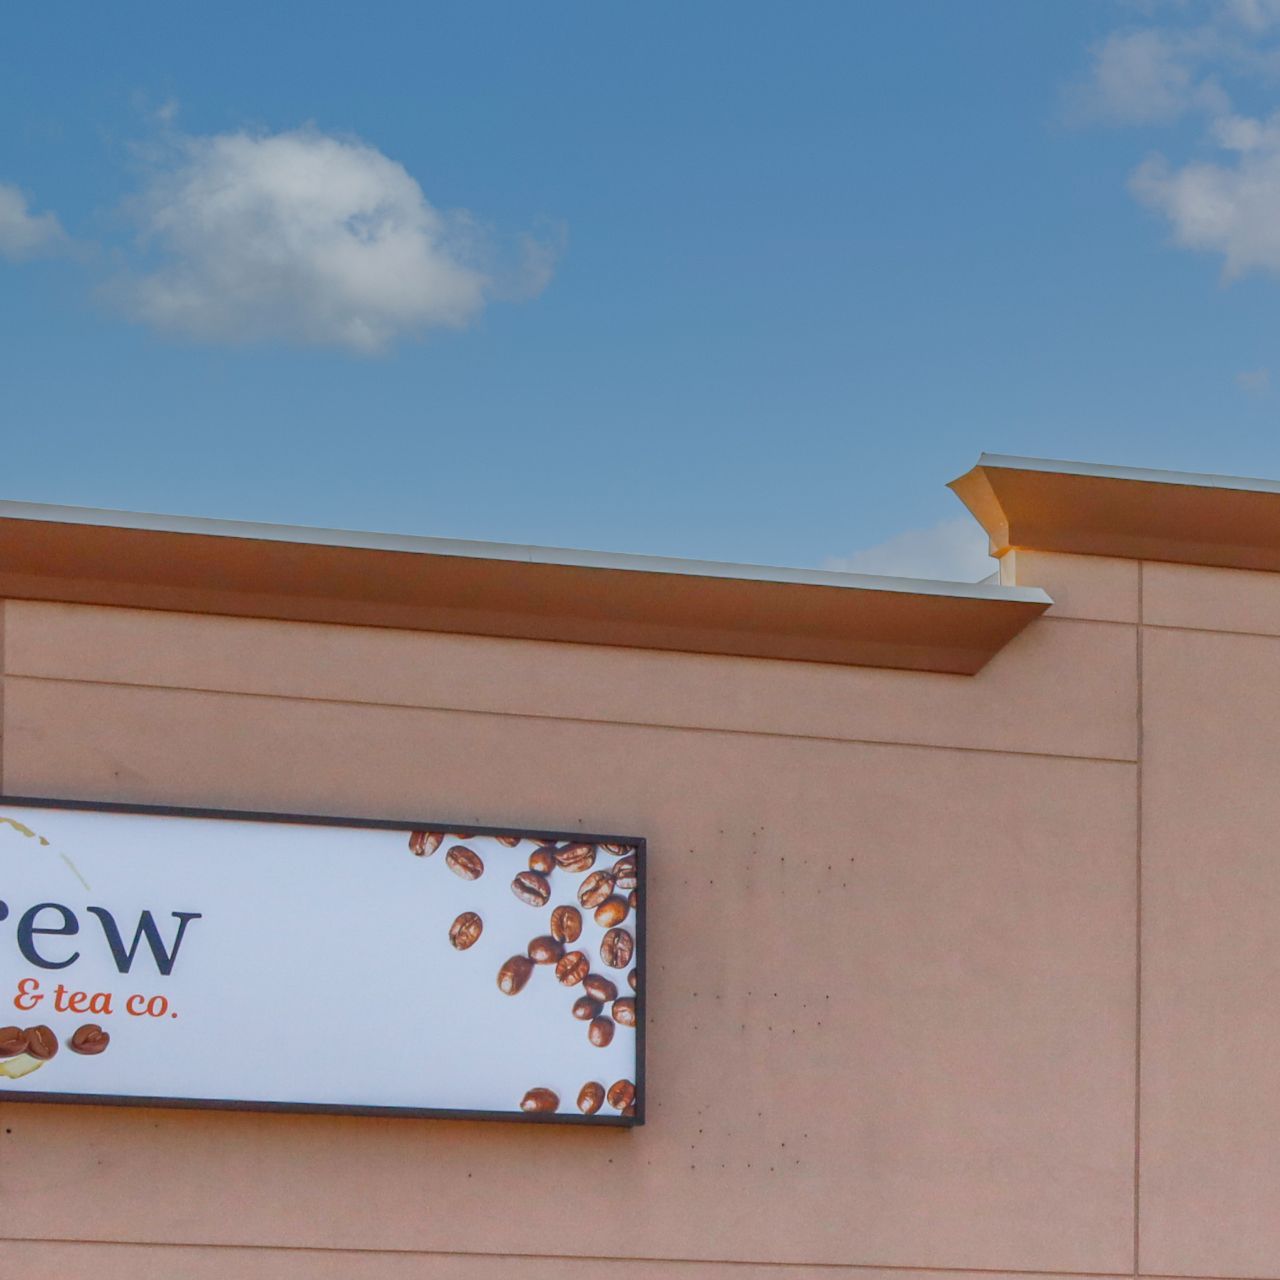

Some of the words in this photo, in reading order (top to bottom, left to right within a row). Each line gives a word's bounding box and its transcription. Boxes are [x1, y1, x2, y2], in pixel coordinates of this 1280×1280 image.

[0, 900, 202, 976] ew
[13, 978, 45, 1011] &
[54, 984, 113, 1014] tea
[126, 994, 178, 1019] co.
